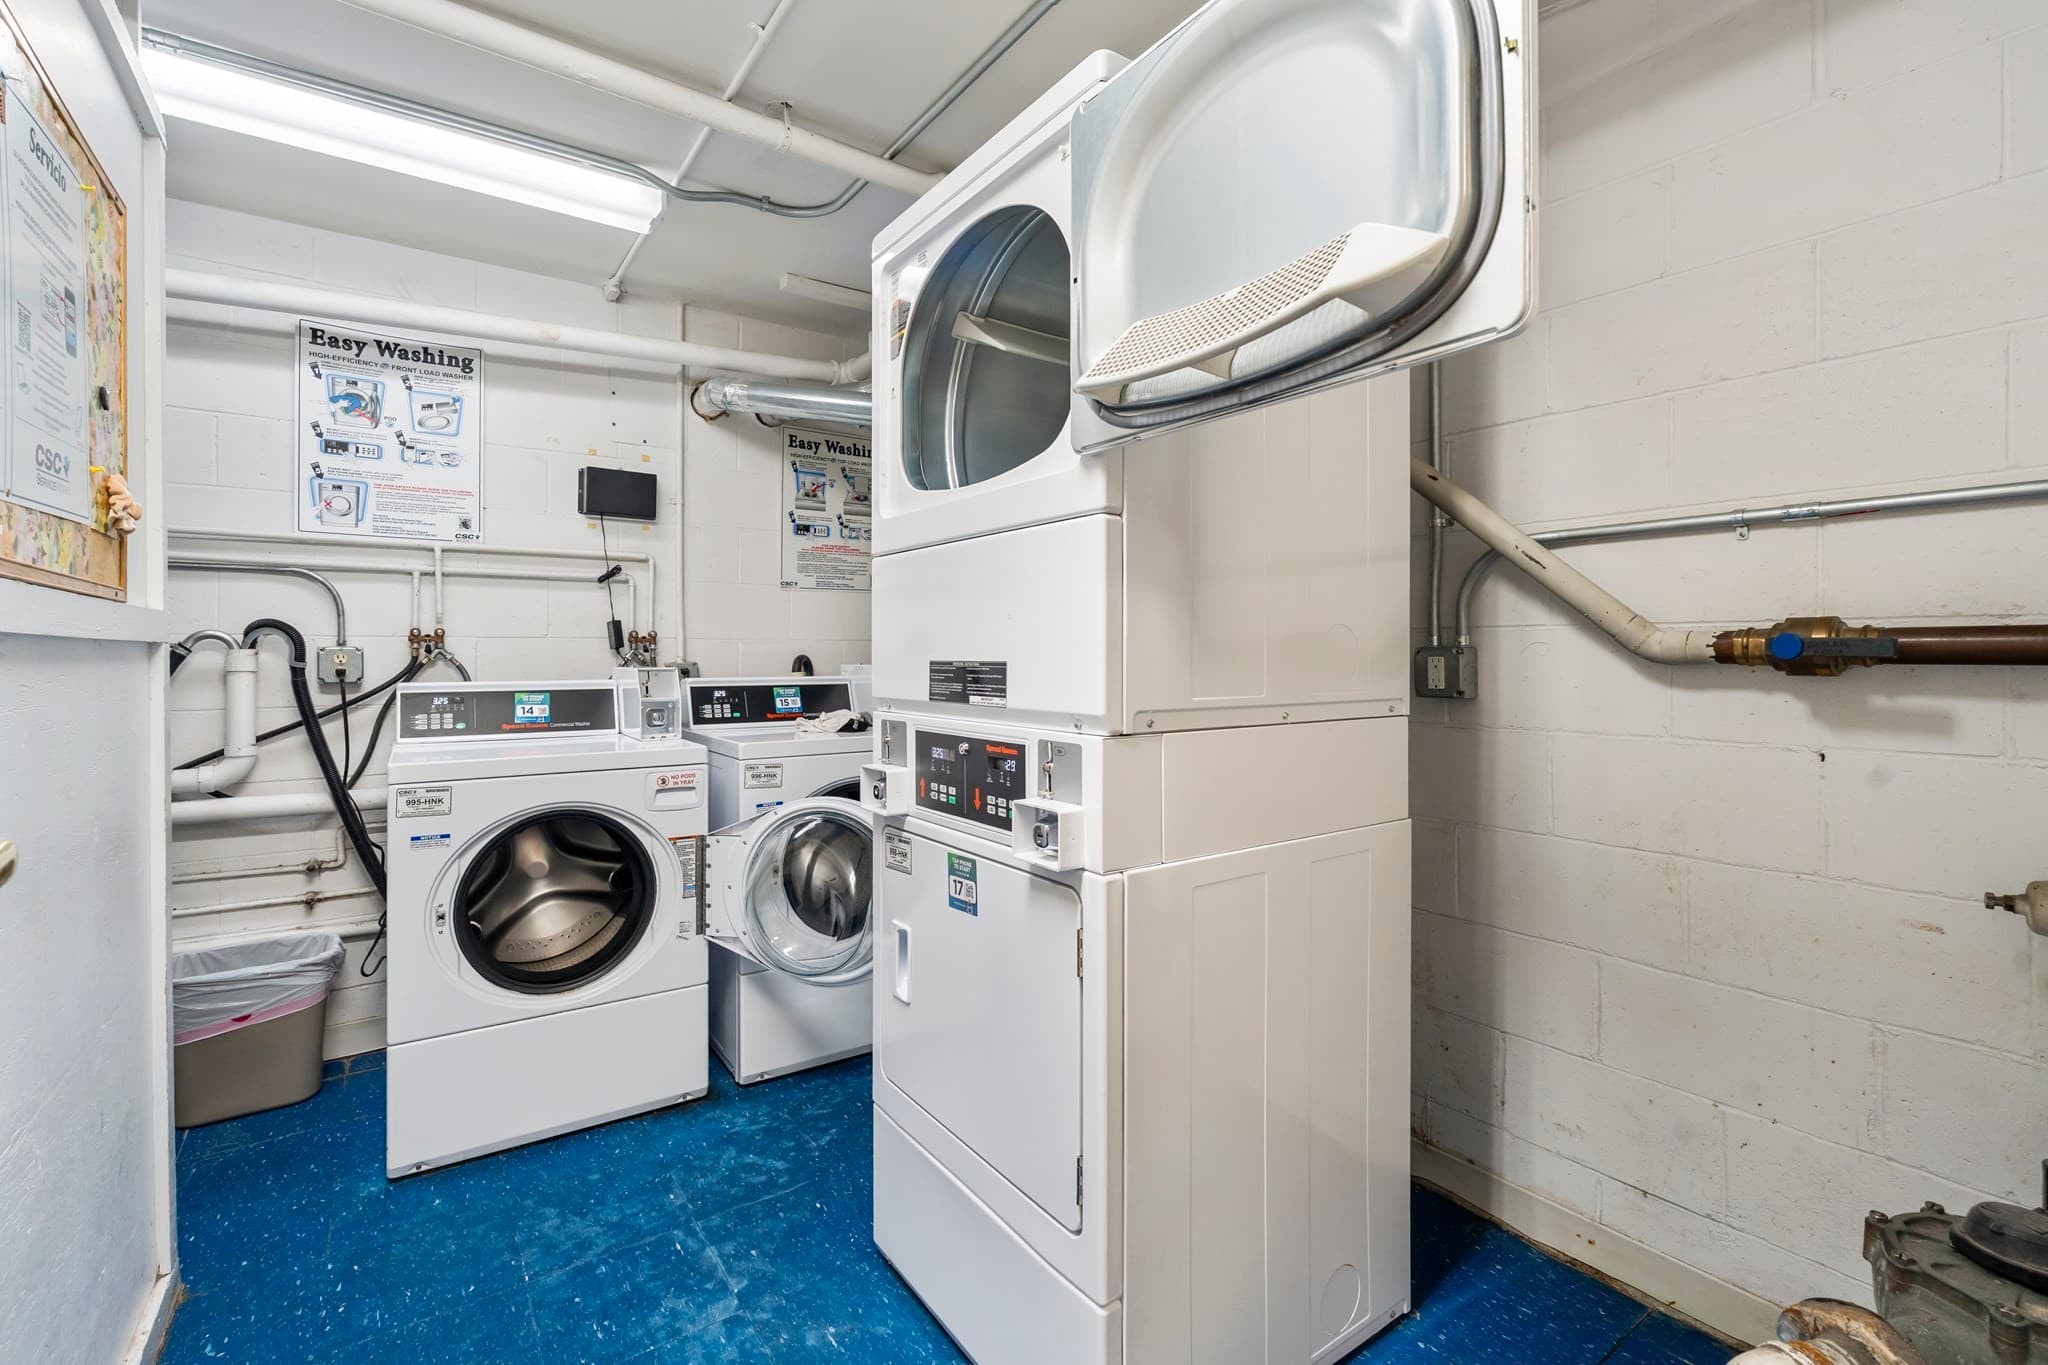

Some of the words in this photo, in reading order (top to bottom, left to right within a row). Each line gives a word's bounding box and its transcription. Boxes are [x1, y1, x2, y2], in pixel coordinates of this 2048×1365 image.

[29, 127, 67, 192] Servicio
[308, 327, 368, 358] Easy
[373, 339, 474, 374] Washing
[308, 351, 380, 368] HIGH-EFFICIENCY
[391, 364, 417, 374] FRONT
[419, 368, 441, 377] LOAD
[442, 371, 474, 381] WASHER
[787, 433, 822, 455] Easy
[35, 443, 62, 475] CSC
[520, 706, 534, 716] 14
[779, 698, 790, 707] 15
[405, 797, 445, 807] 995-HNK
[952, 879, 964, 897] 17
